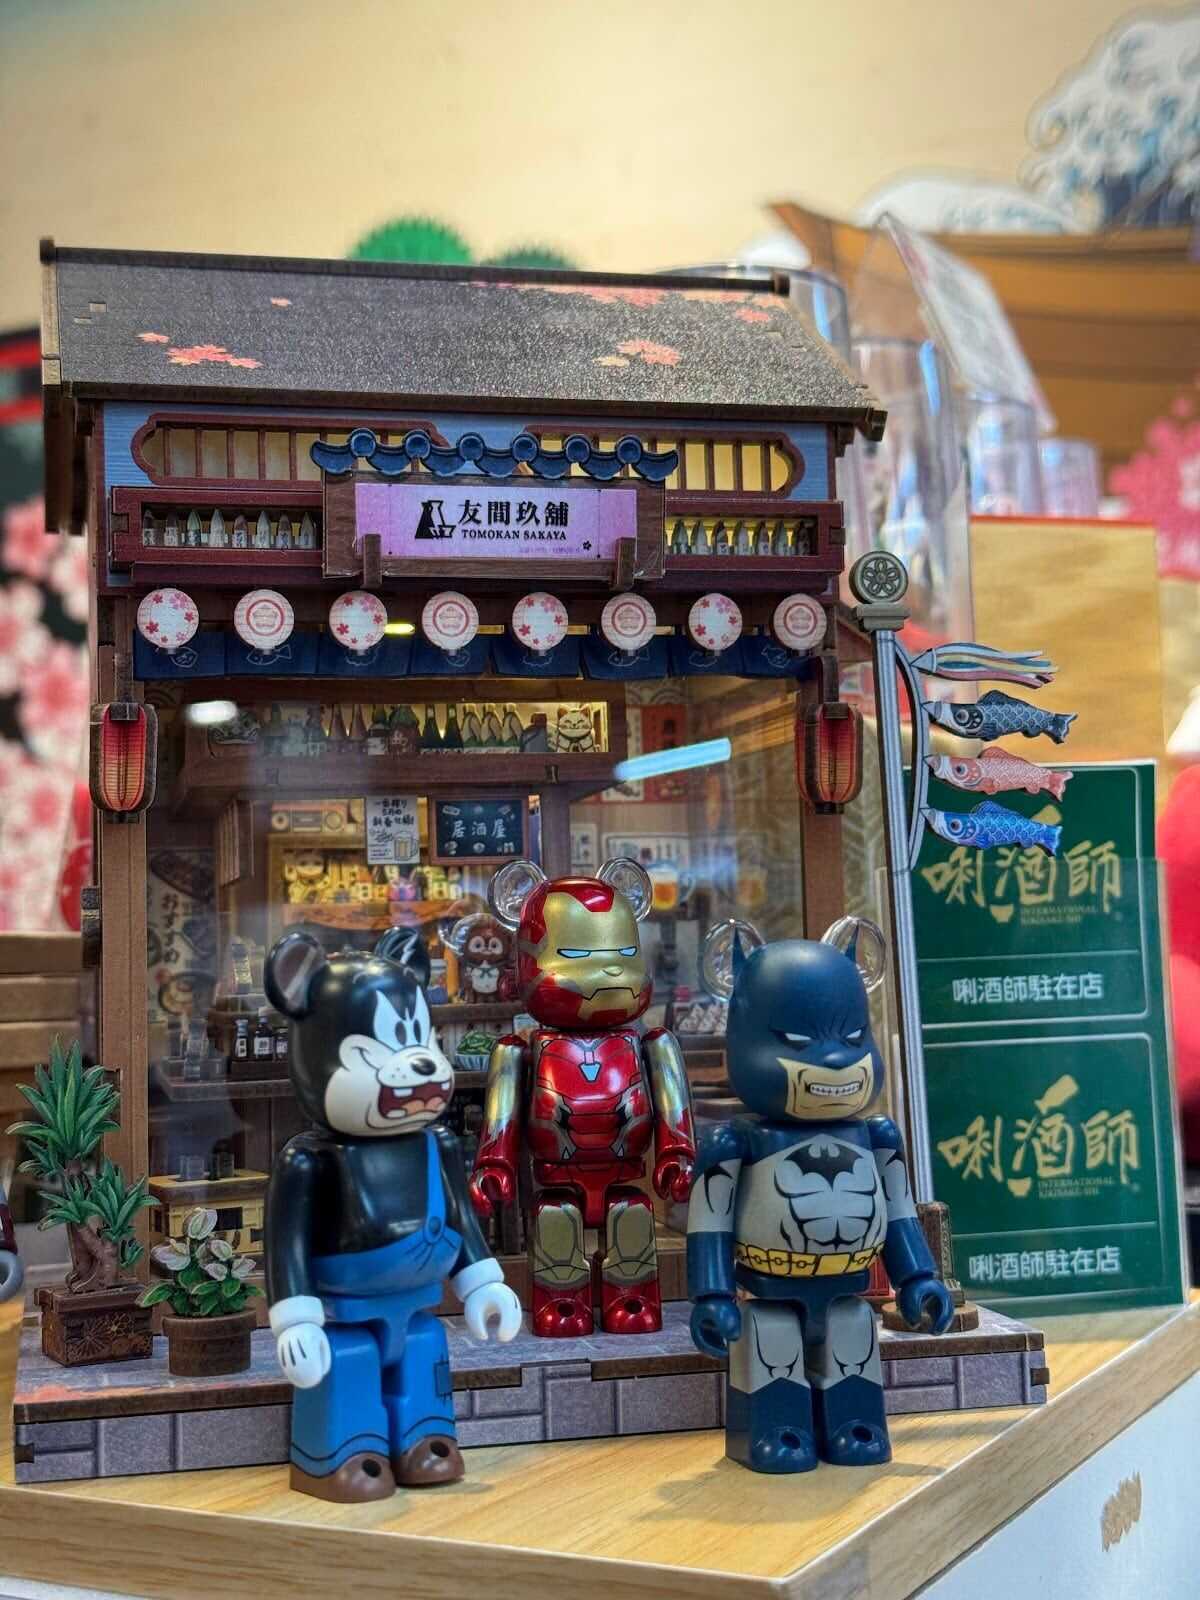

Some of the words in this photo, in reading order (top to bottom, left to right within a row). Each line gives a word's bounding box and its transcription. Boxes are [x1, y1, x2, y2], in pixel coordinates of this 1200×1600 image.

[461, 529, 520, 540] TOMOKAN
[523, 530, 567, 541] SAKAYA
[452, 818, 506, 838] 居酒屋
[921, 839, 1121, 914] 唎酒師
[952, 971, 1105, 1005] 唎酒師駐在店
[937, 1108, 1140, 1185] 唎酒師
[968, 1245, 1121, 1281] 唎酒師駐在店
